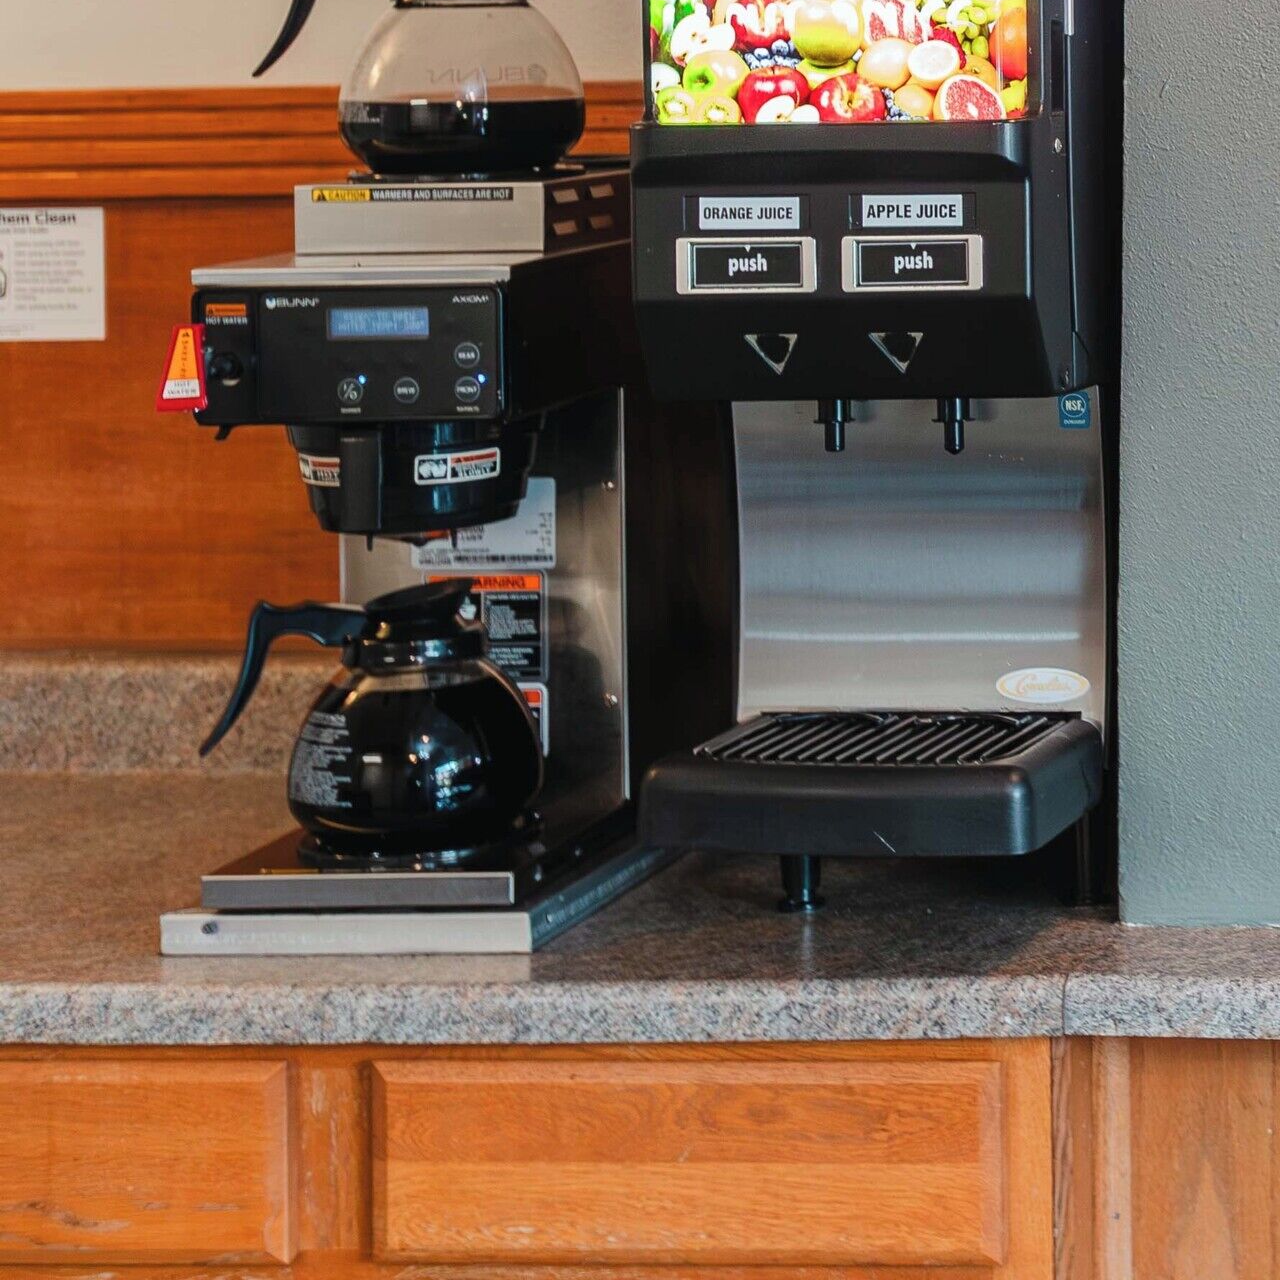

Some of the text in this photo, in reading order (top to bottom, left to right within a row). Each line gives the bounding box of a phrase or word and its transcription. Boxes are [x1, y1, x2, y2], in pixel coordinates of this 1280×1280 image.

[372, 189, 412, 200] WARMERS
[414, 189, 431, 200] AND
[432, 189, 474, 200] SURFACES
[475, 189, 492, 200] ARE
[493, 189, 510, 200] HOT
[703, 206, 793, 220] ORANGE JUICE
[866, 204, 957, 219] APPLE JUICE
[728, 253, 768, 276] push
[893, 250, 933, 273] push
[276, 297, 317, 308] BUNN
[452, 295, 487, 303] AXIOM
[206, 316, 247, 325] HOT WATER
[1065, 400, 1083, 411] NSF
[474, 576, 525, 588] ARNING
